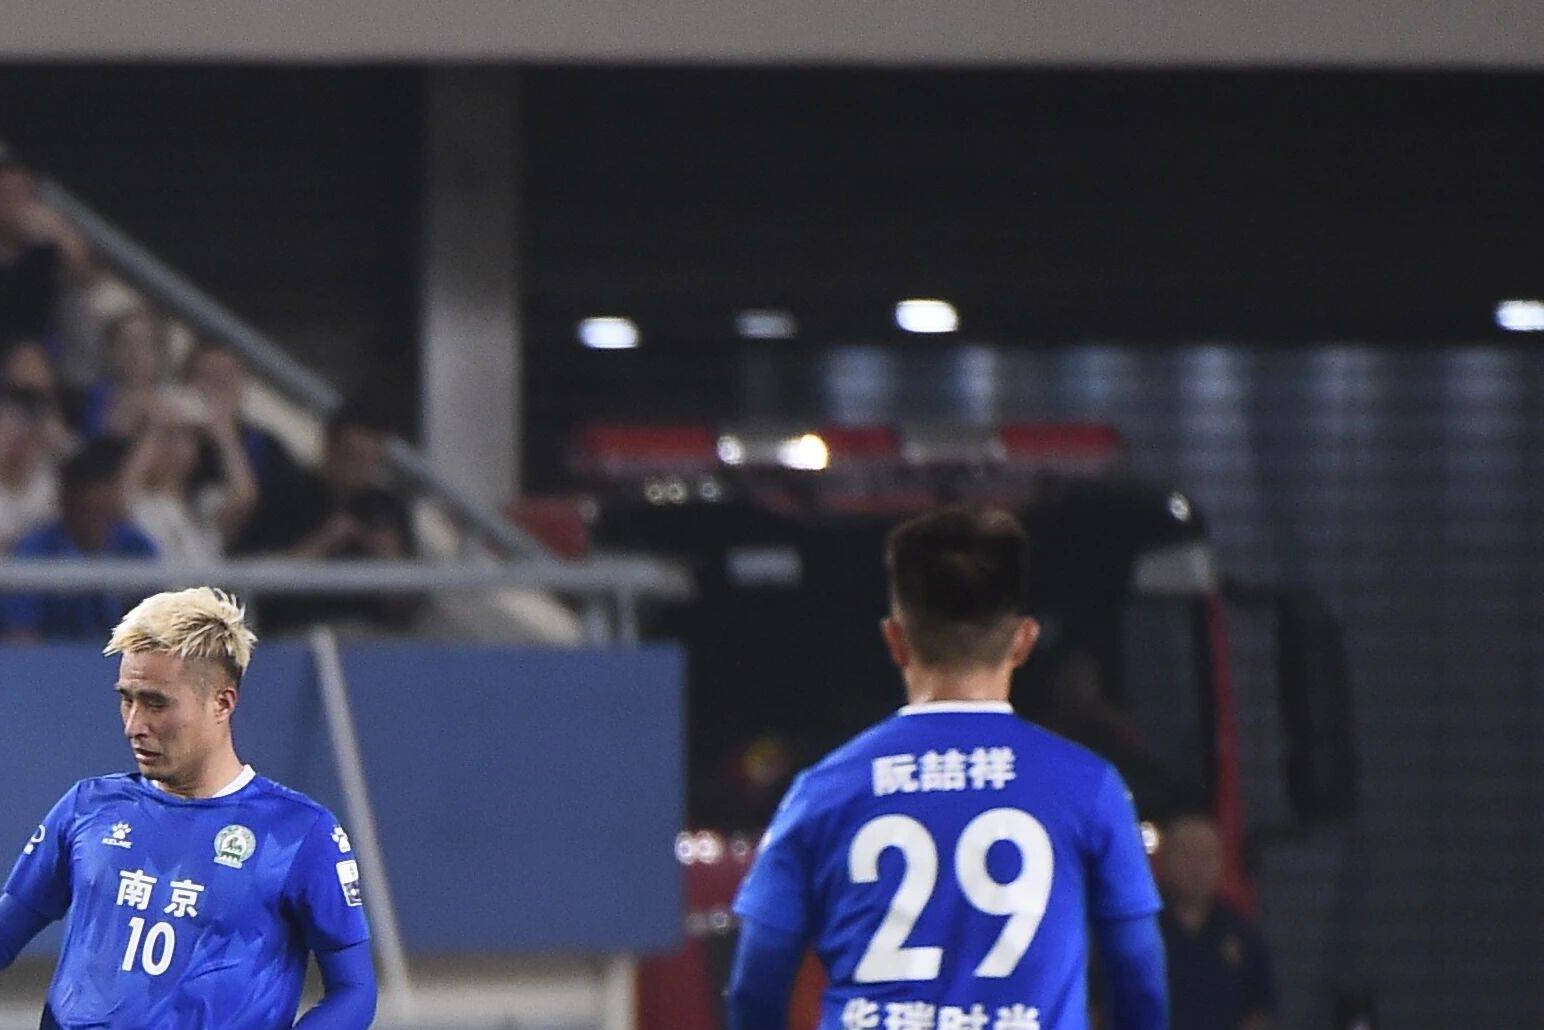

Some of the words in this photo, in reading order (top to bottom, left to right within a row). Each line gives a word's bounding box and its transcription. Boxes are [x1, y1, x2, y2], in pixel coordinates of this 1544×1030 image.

[116, 869, 205, 918] 南京
[848, 807, 1054, 984] 29
[121, 916, 176, 976] 10
